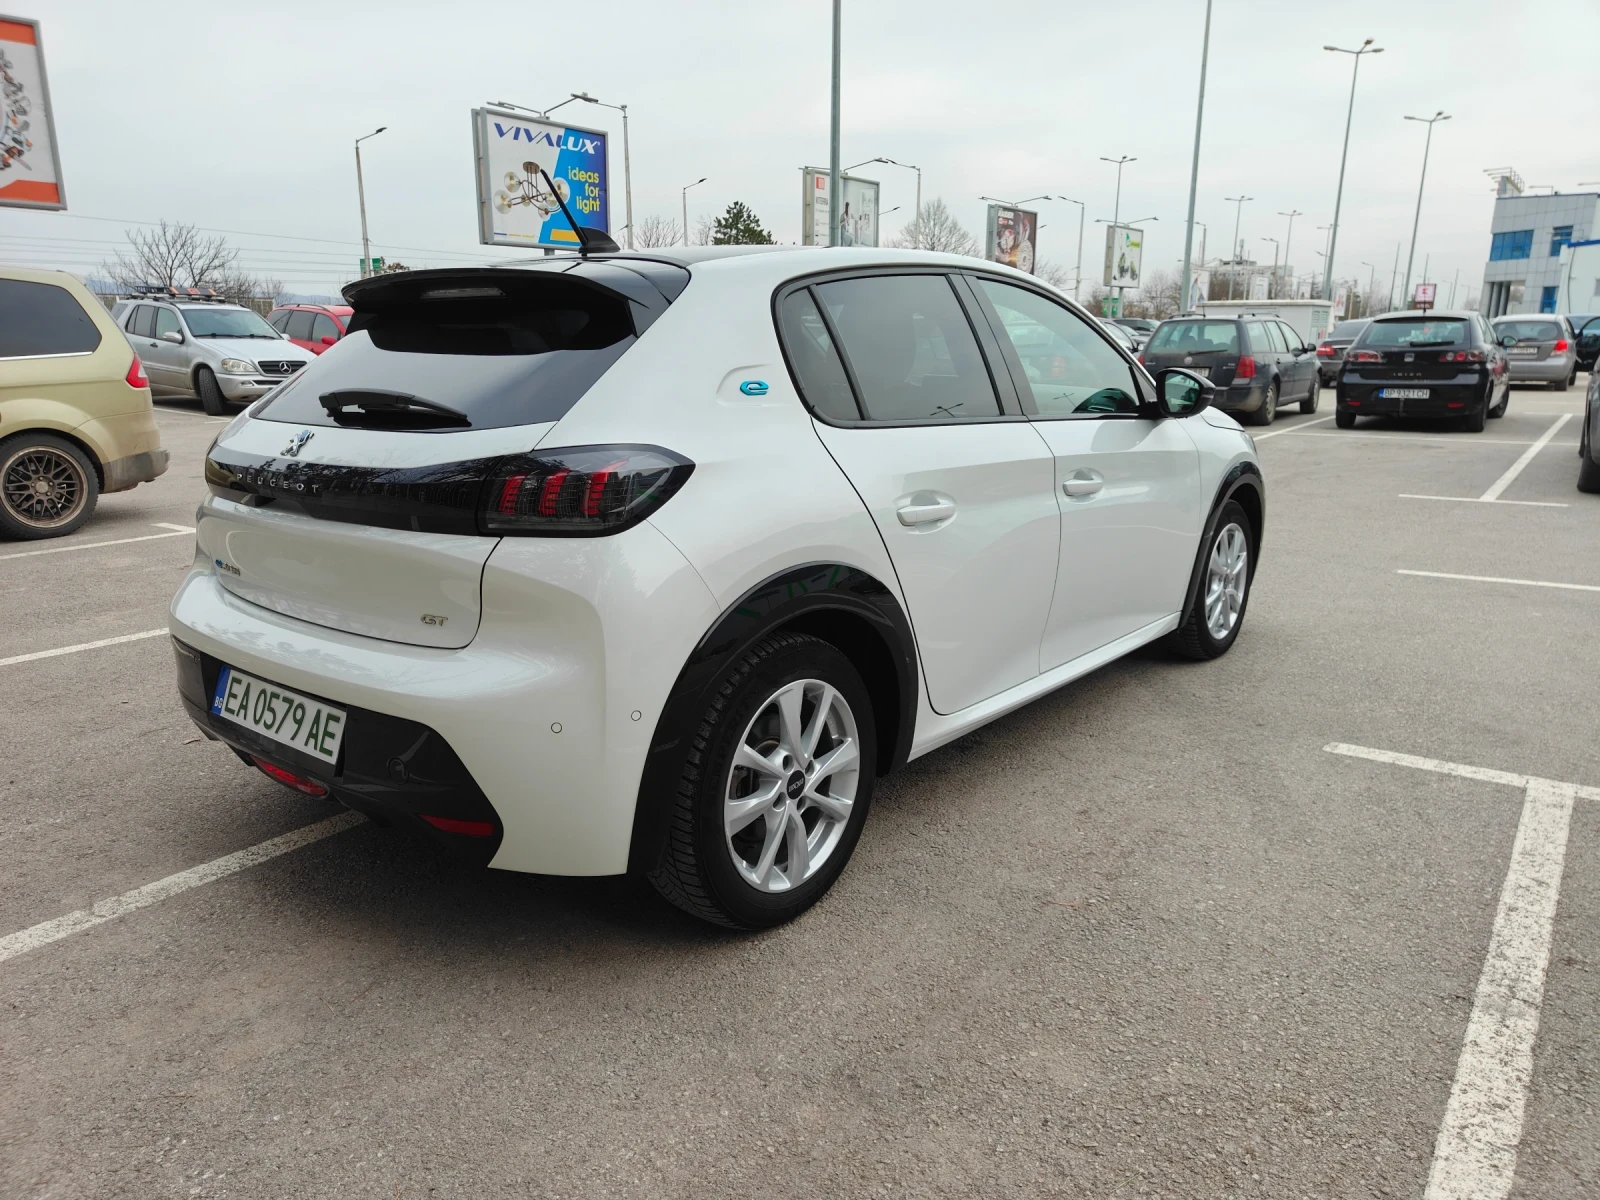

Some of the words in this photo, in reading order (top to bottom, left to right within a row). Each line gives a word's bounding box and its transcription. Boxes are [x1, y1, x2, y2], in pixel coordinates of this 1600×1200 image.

[568, 166, 599, 183] ideas
[584, 184, 599, 198] for
[576, 197, 600, 214] light
[237, 473, 319, 494] PEUGEOT
[420, 614, 449, 627] GT
[214, 696, 224, 709] BG
[224, 676, 251, 721] EA
[252, 688, 306, 741] 0579
[304, 708, 341, 757] AE
